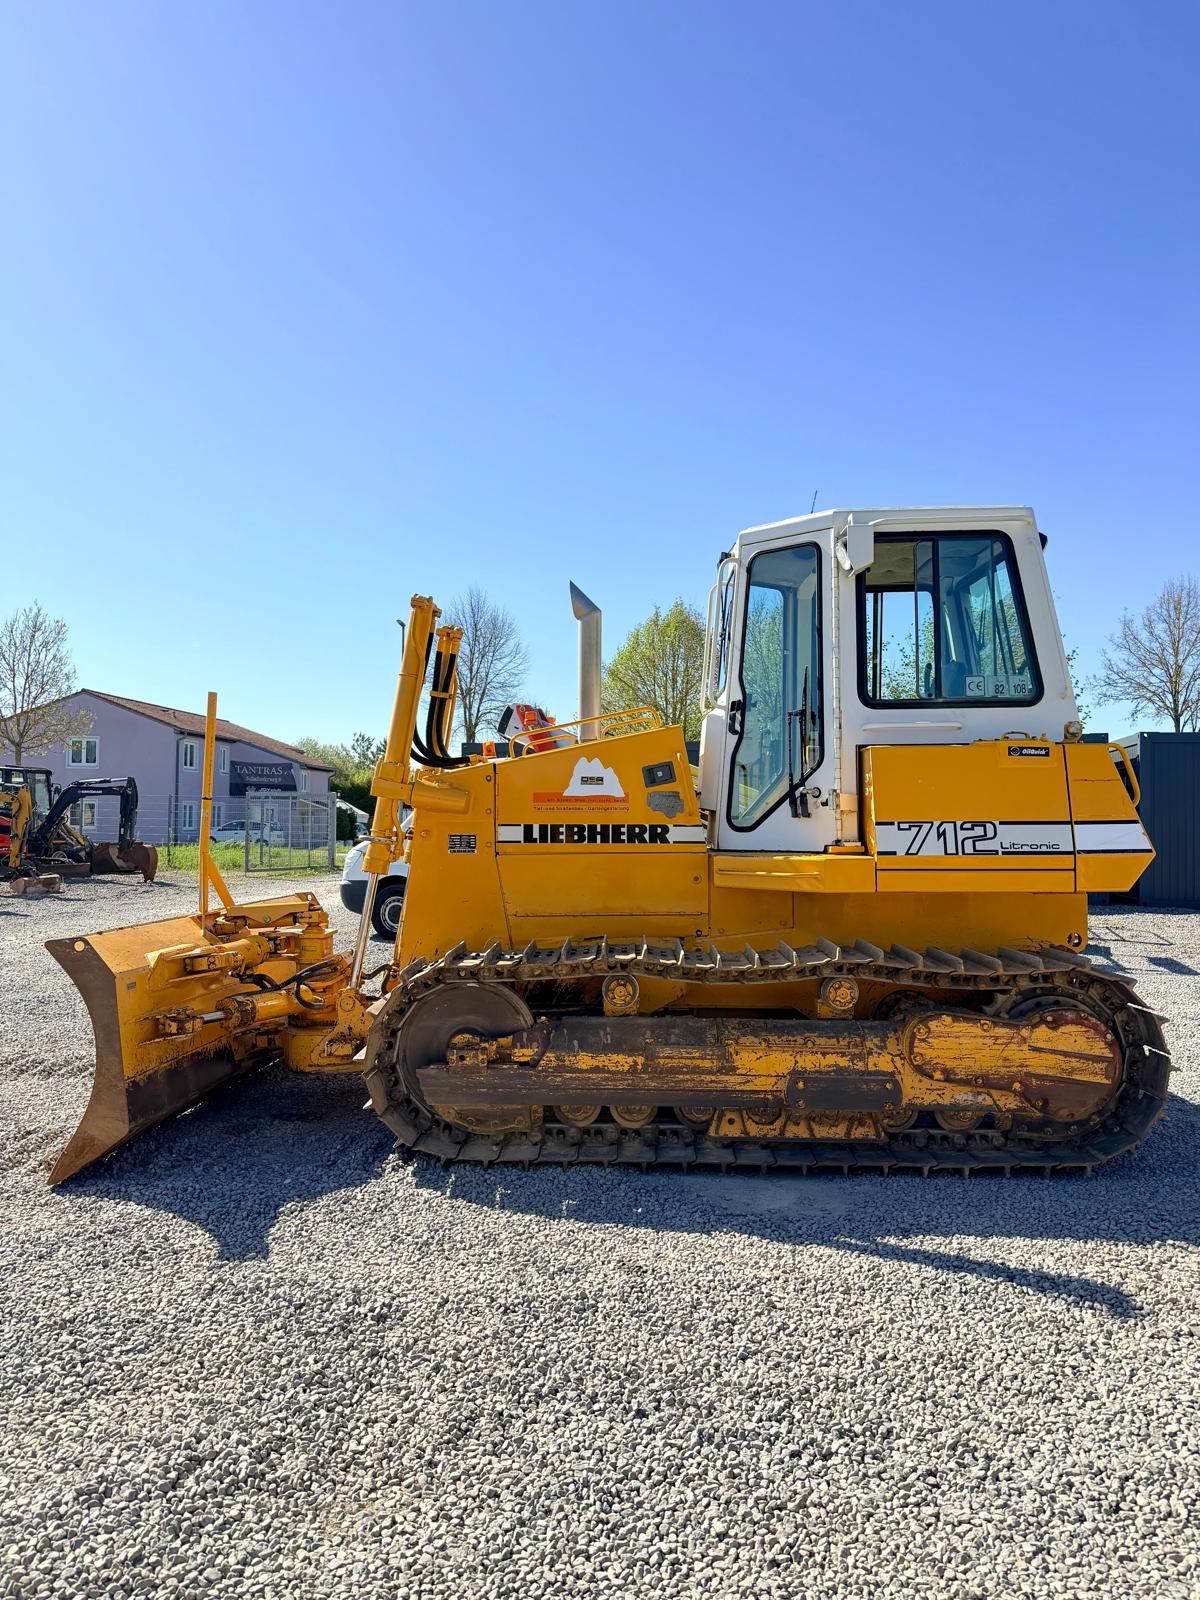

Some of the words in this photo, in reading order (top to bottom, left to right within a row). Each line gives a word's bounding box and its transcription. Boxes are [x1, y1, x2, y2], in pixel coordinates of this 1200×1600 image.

[994, 683, 1005, 695] 82
[1012, 683, 1027, 695] 108
[235, 765, 283, 775] TANTRAS
[523, 824, 670, 844] LIEBHERR
[896, 821, 1000, 856] 712
[1000, 841, 1061, 850] Litronic
